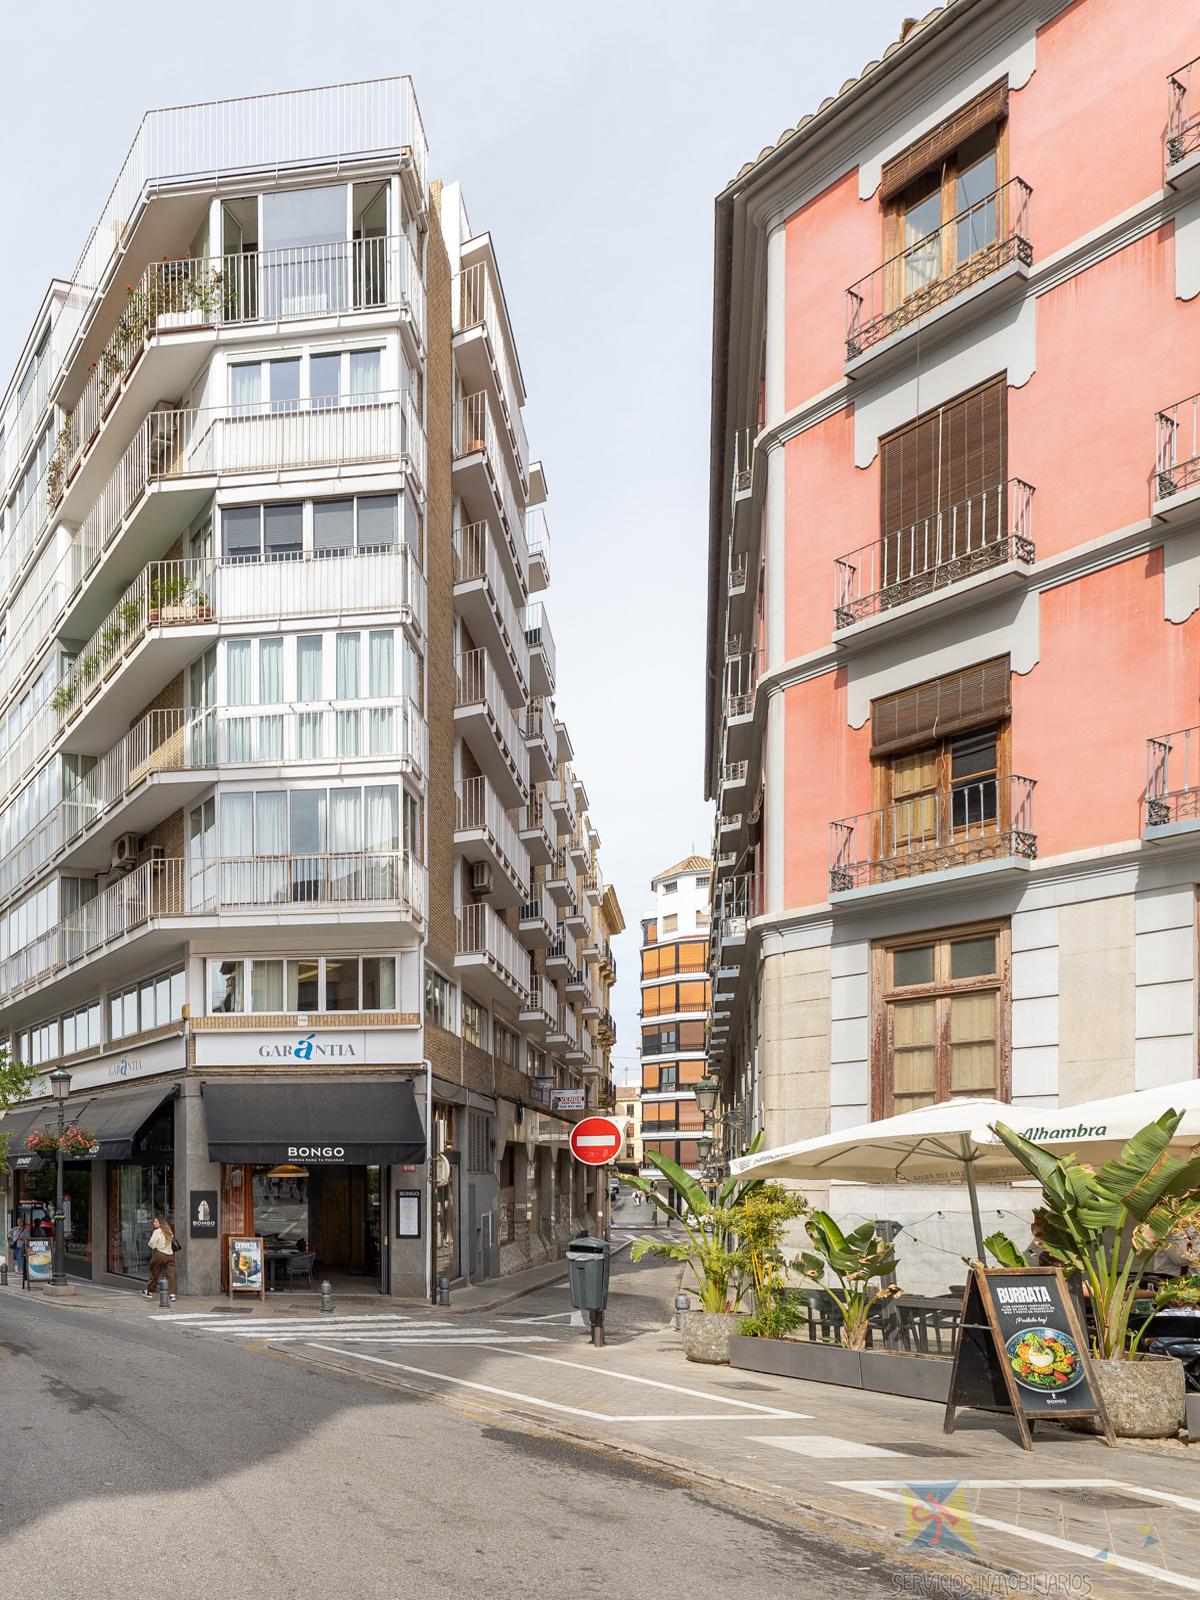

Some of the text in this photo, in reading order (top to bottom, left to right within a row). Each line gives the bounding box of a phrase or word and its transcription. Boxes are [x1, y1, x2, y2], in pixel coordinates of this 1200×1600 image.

[1018, 1124, 1108, 1141] Alhambra
[288, 1147, 345, 1157] BONGO
[996, 1286, 1052, 1304] BURRATA
